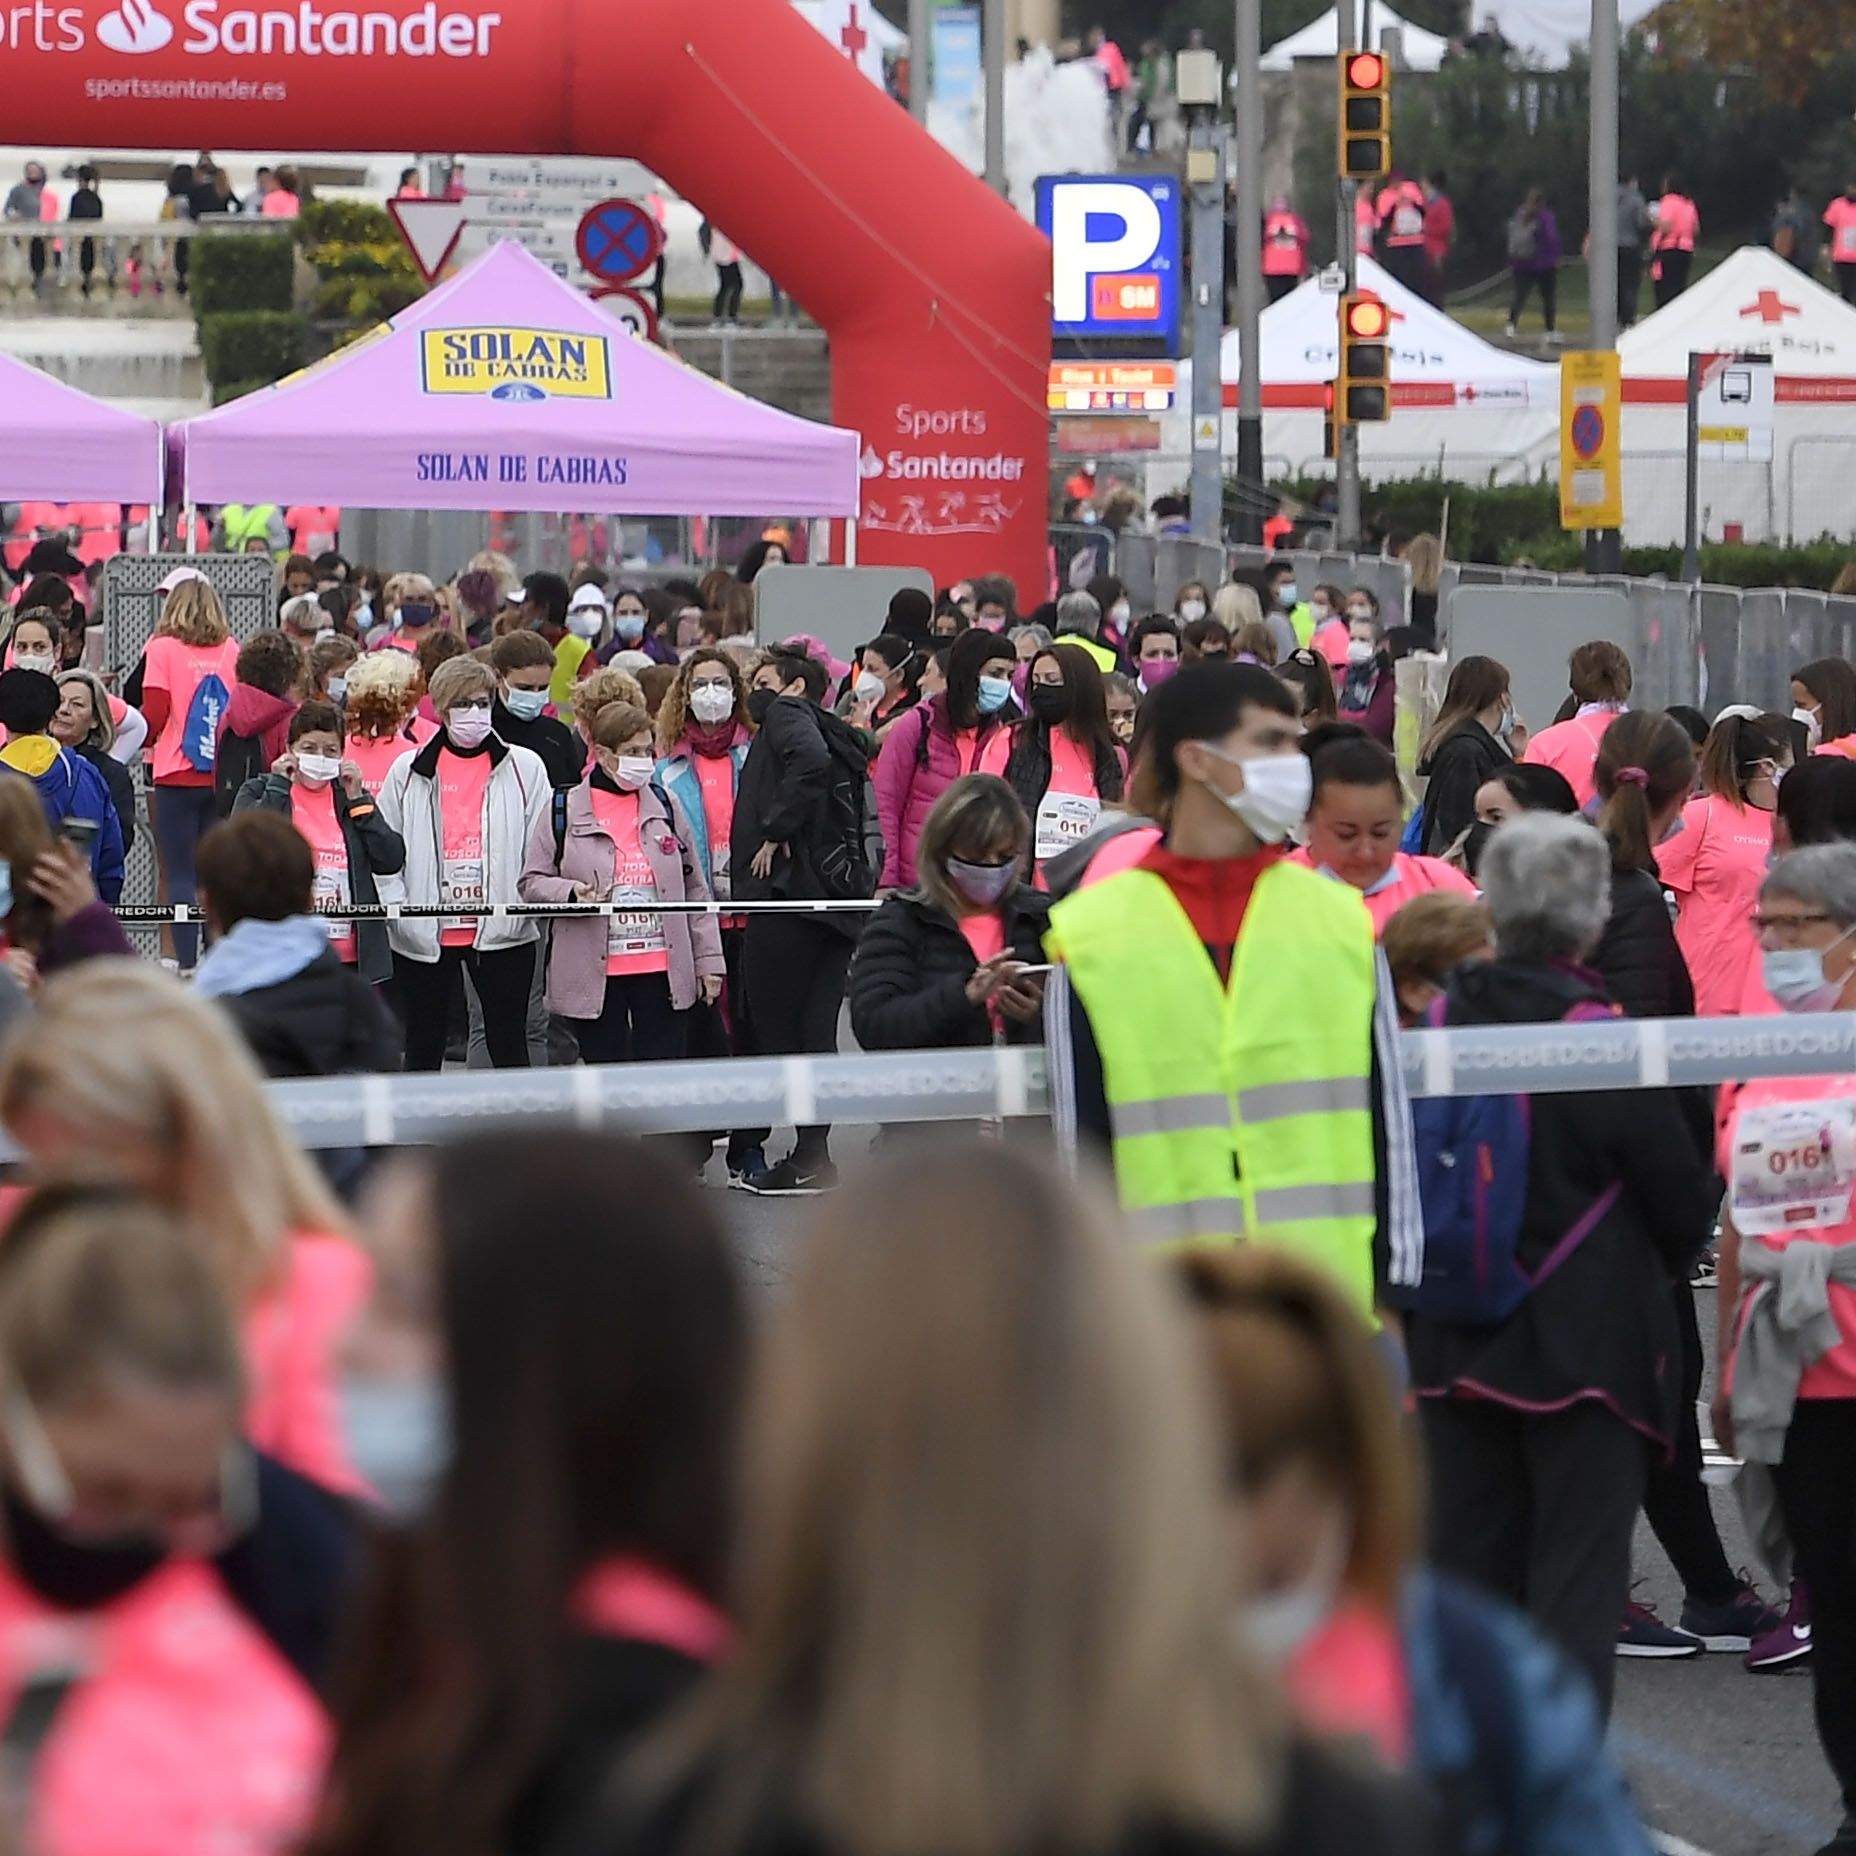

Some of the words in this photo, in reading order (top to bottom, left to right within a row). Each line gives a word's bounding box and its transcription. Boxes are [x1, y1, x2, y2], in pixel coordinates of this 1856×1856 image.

[84, 75, 288, 101] sportssantander.es
[1053, 184, 1161, 322] P
[445, 362, 476, 377] DE
[488, 362, 587, 381] CABRAS
[896, 403, 987, 439] Sports
[499, 455, 526, 482] DE
[537, 455, 627, 485] CABRAS
[887, 450, 1025, 481] Santander
[1769, 1146, 1820, 1176] 016
